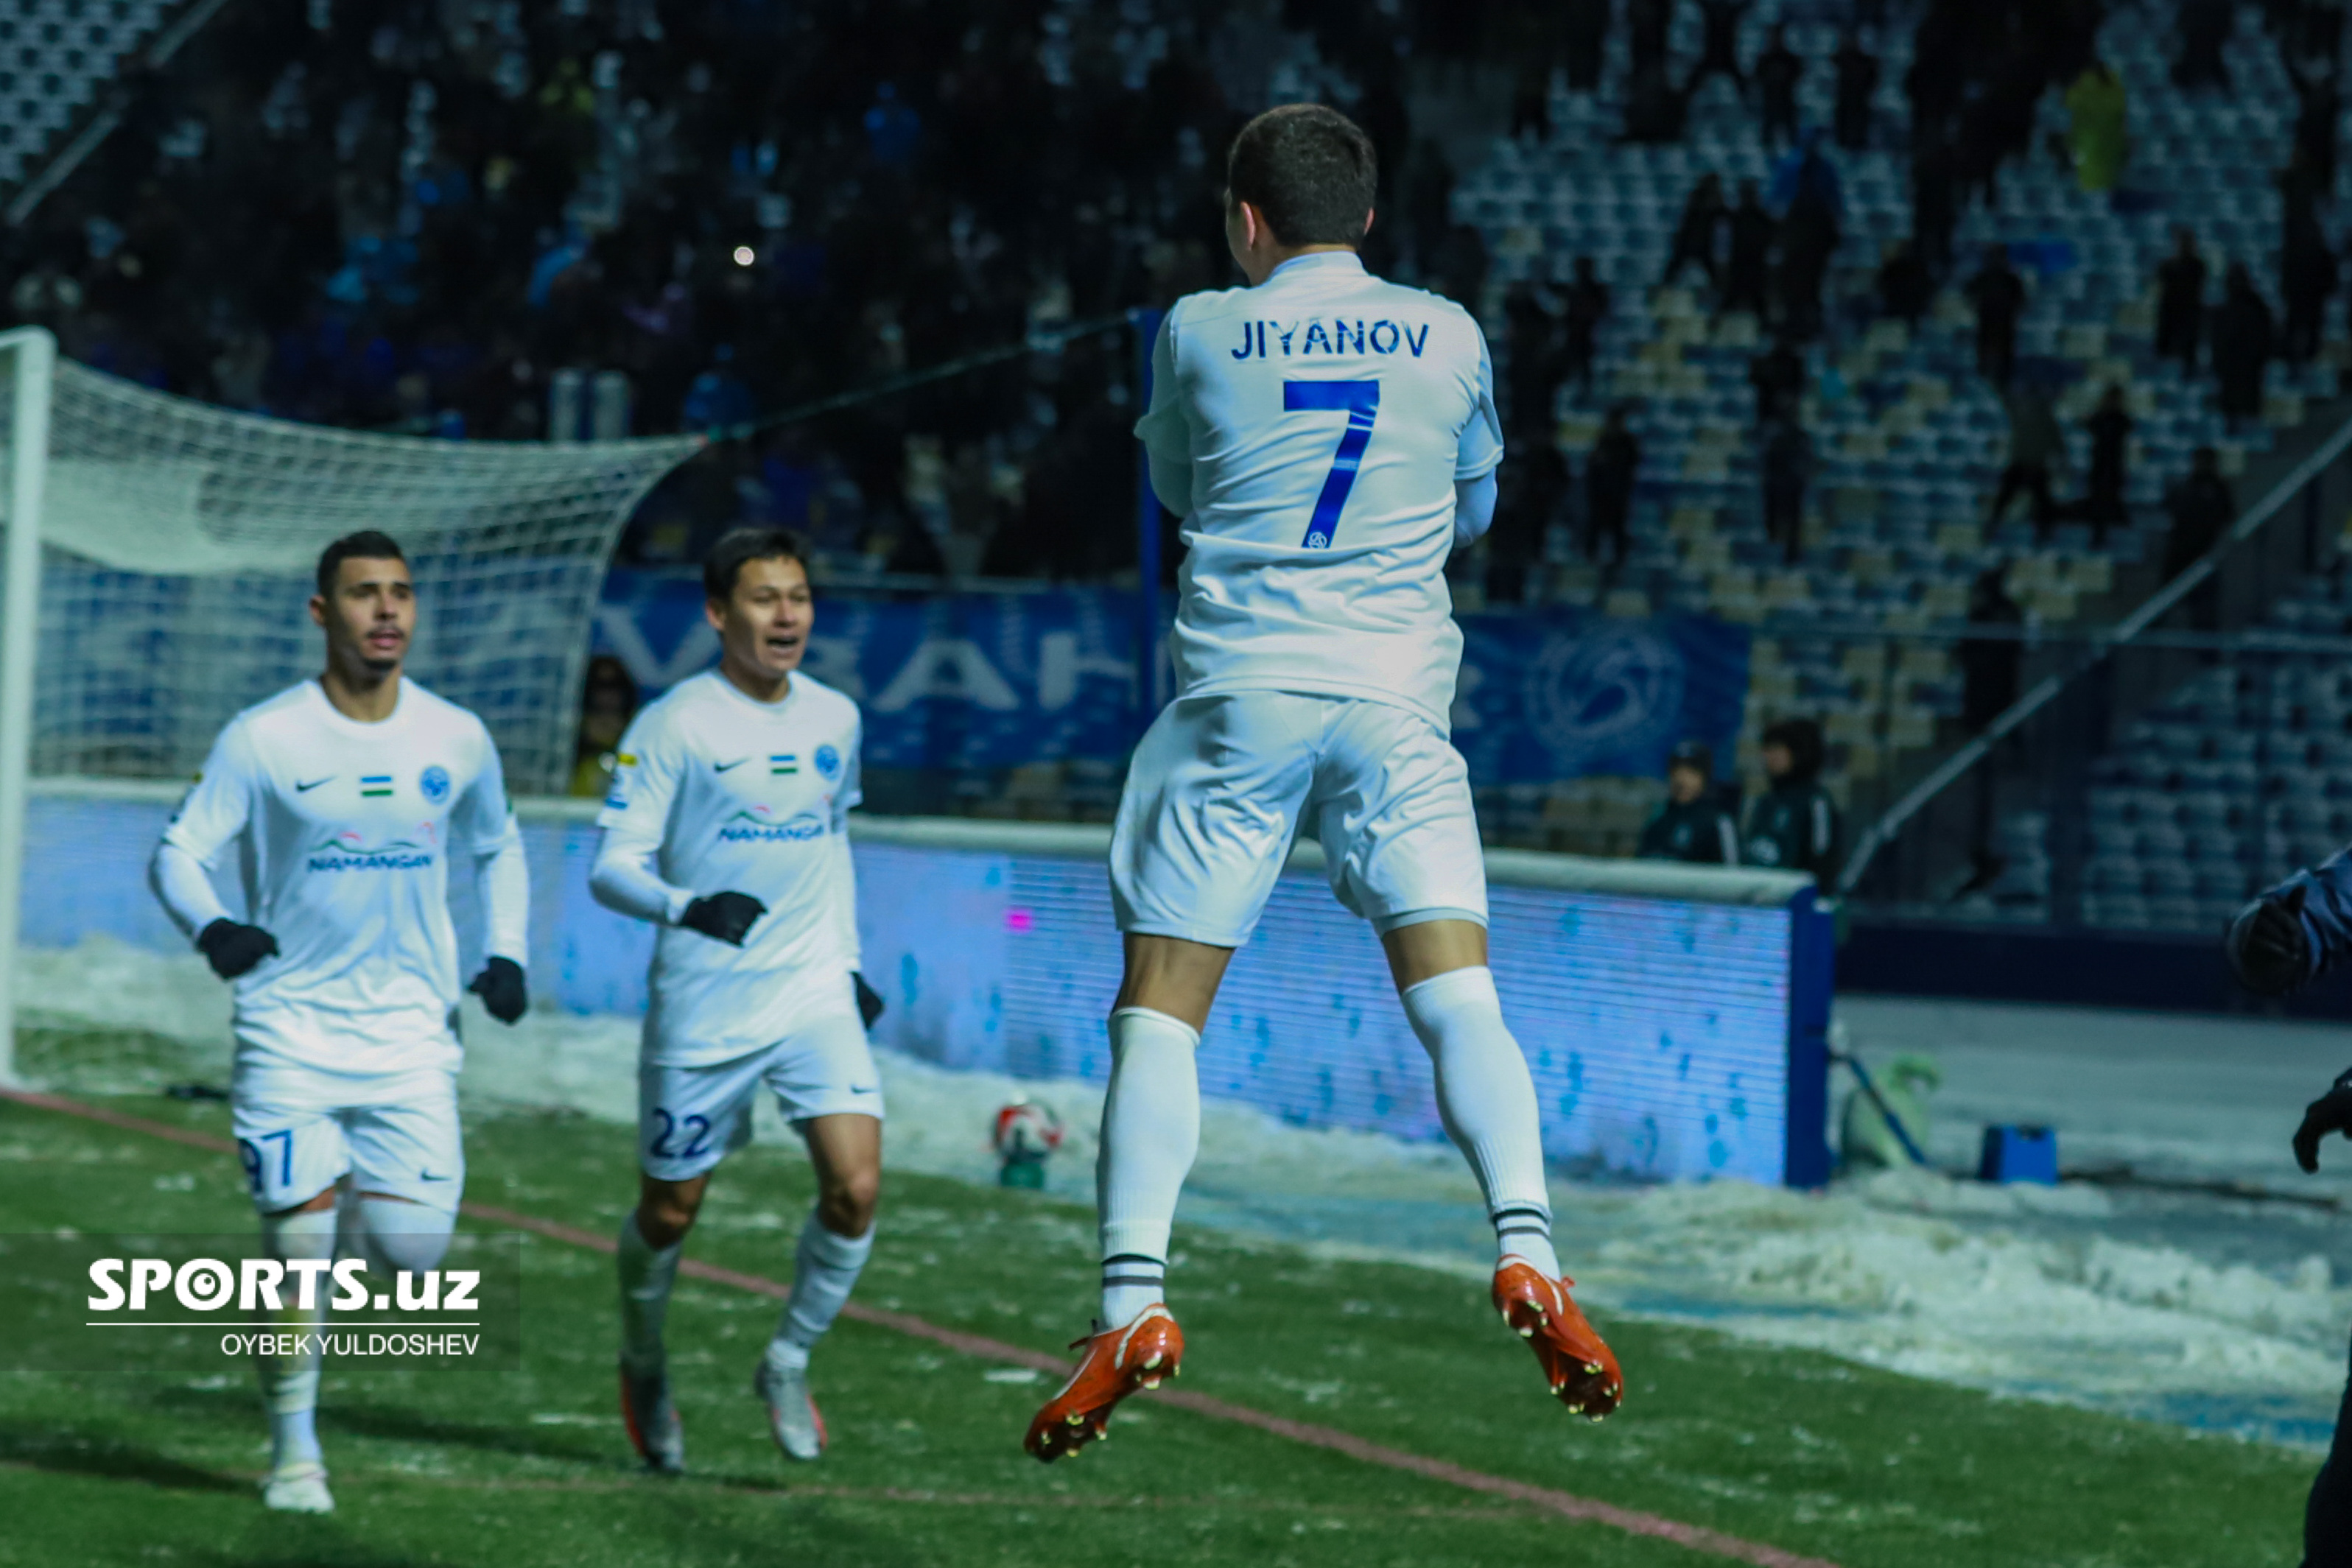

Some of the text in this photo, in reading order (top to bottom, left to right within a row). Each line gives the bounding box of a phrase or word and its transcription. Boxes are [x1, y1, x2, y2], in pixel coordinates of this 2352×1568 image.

[1231, 319, 1429, 359] JIYANOV
[1283, 379, 1380, 548] 7
[238, 1129, 292, 1192] 97
[650, 1108, 710, 1159] 22
